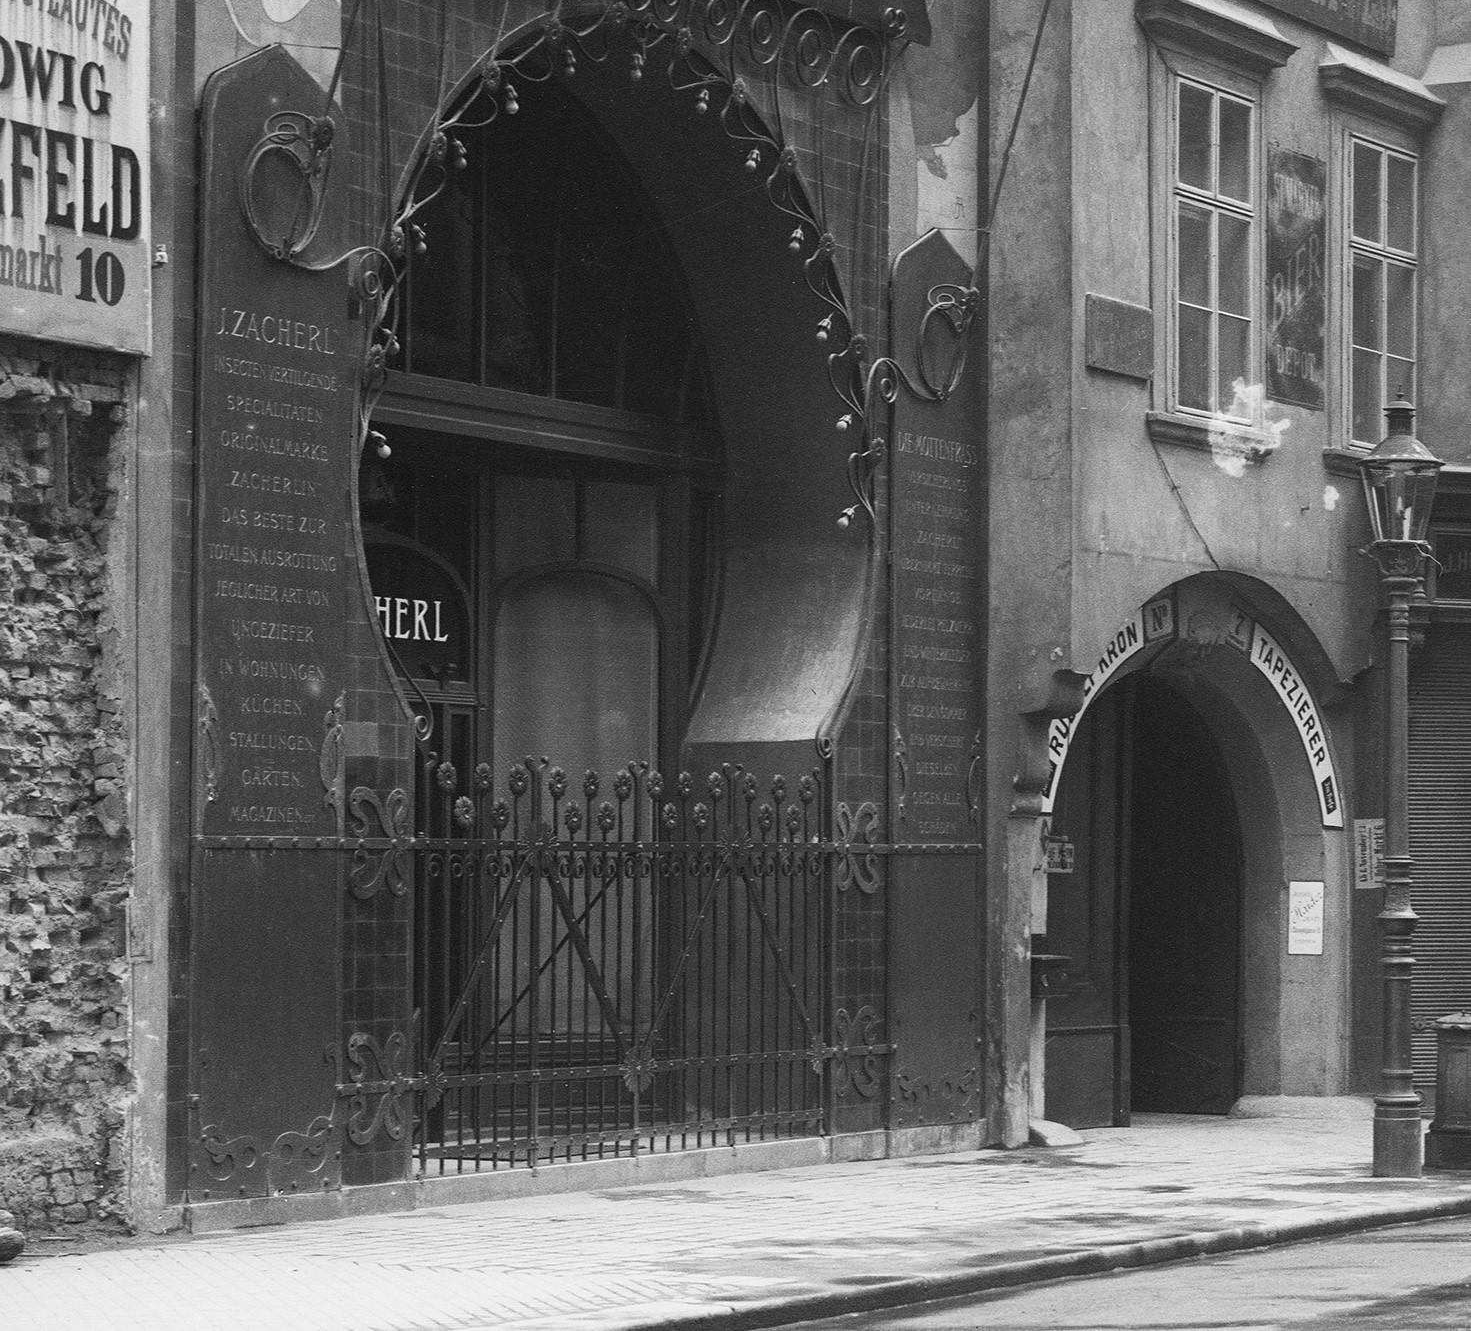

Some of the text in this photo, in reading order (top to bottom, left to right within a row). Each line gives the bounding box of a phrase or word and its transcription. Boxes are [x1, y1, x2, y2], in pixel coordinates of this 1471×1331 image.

[0, 118, 141, 241] FELD
[75, 246, 125, 306] 10
[1272, 233, 1322, 333] BIER
[222, 507, 327, 535] DAS BESTE ZUR
[215, 580, 278, 602] JEGLICHER
[231, 619, 315, 643] UNGEZIEFER
[239, 659, 326, 681] WOHNUNGEN
[1260, 637, 1326, 767] TAPEZIERER
